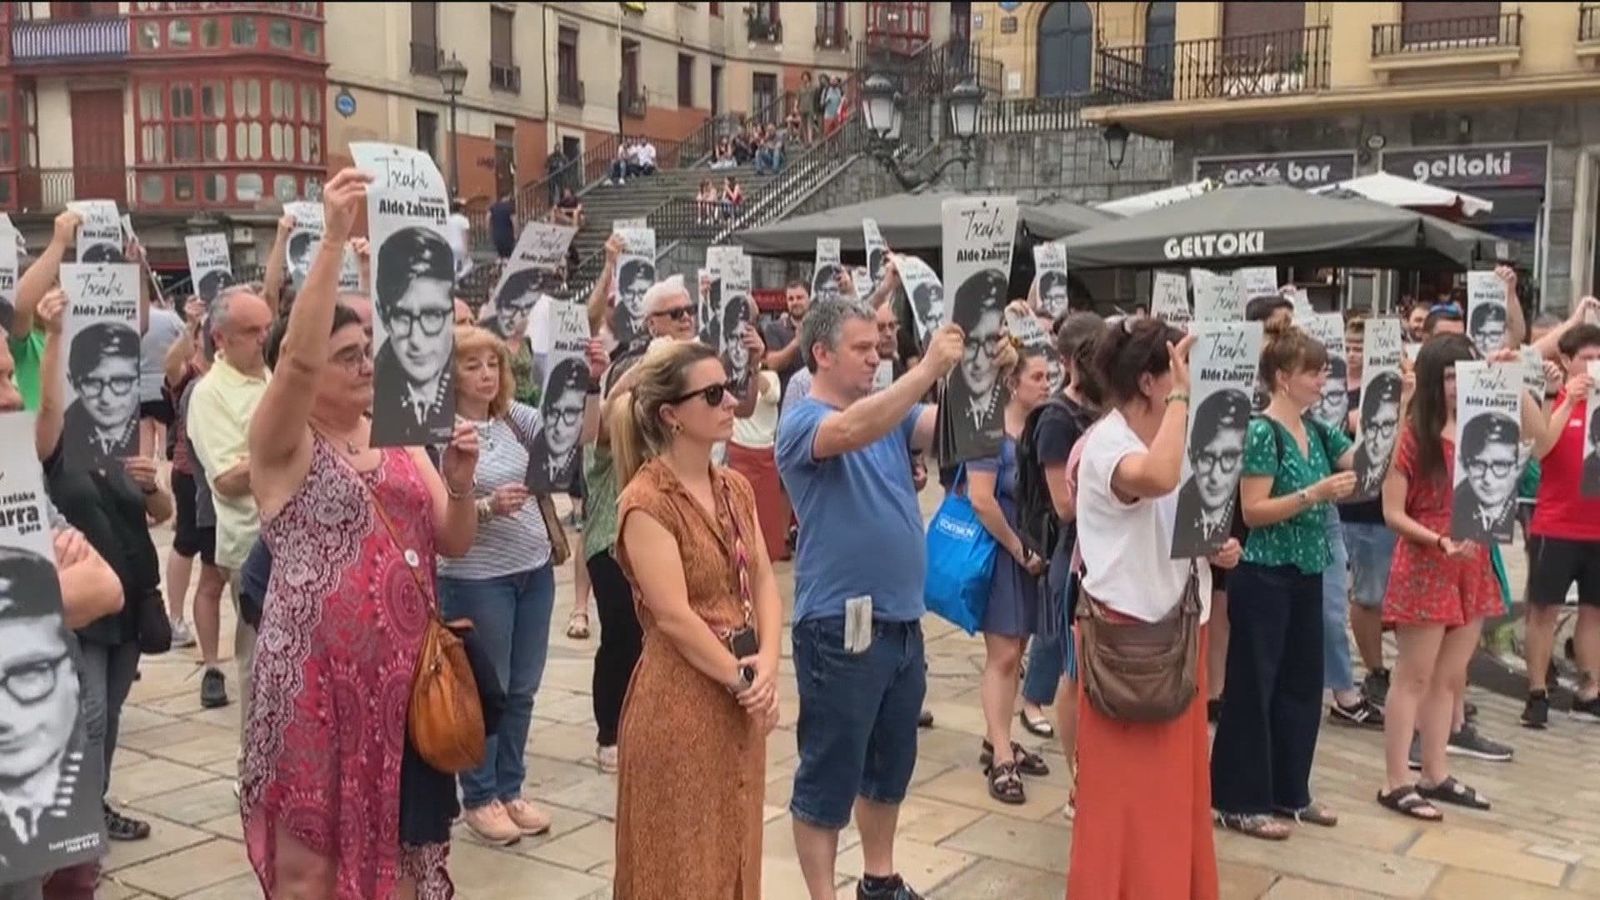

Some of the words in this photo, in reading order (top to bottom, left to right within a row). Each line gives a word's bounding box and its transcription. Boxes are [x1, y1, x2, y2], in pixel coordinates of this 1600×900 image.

[1288, 161, 1331, 183] bar
[1413, 151, 1511, 184] geltoki
[379, 198, 405, 216] Alde
[406, 200, 447, 218] Zaharra
[1163, 230, 1265, 260] GELTOKI
[956, 248, 980, 264] Alde
[72, 304, 96, 316] Alde
[97, 304, 137, 316] Zaharra
[1200, 368, 1221, 381] Alde
[1465, 395, 1483, 406] Alde
